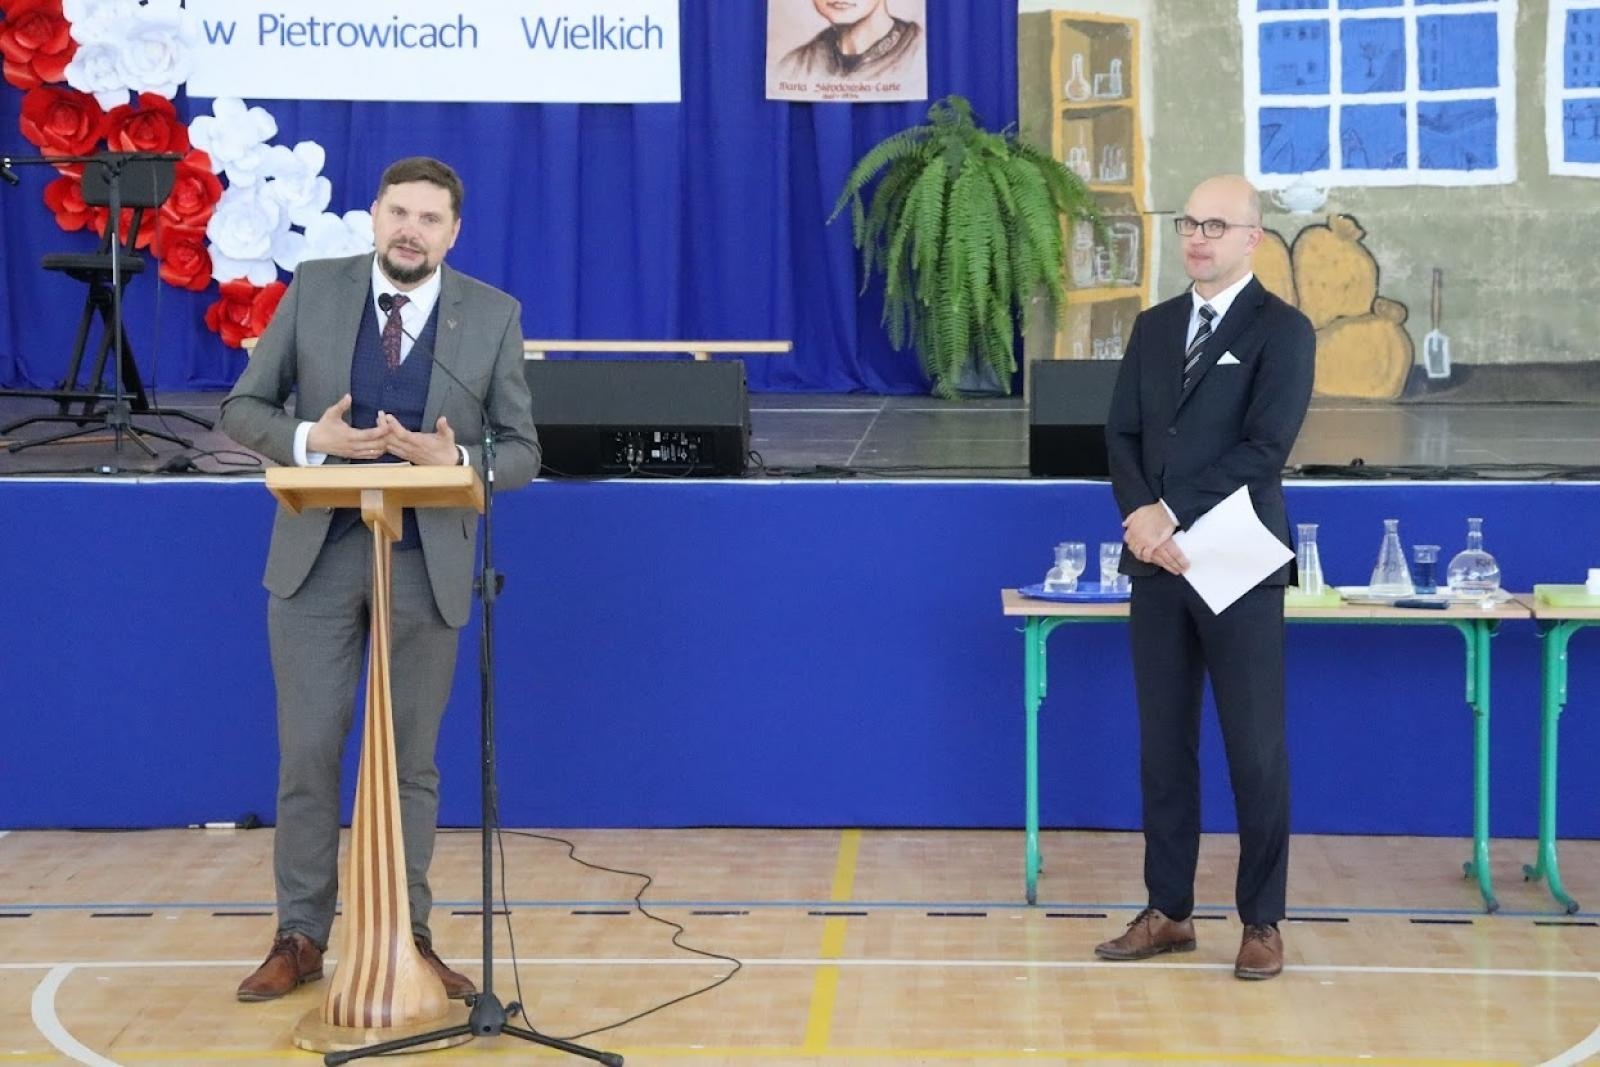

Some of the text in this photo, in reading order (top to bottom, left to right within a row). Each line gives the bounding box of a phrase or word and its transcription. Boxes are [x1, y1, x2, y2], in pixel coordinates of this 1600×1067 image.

[202, 13, 663, 50] w Pietrowicach Wielkich
